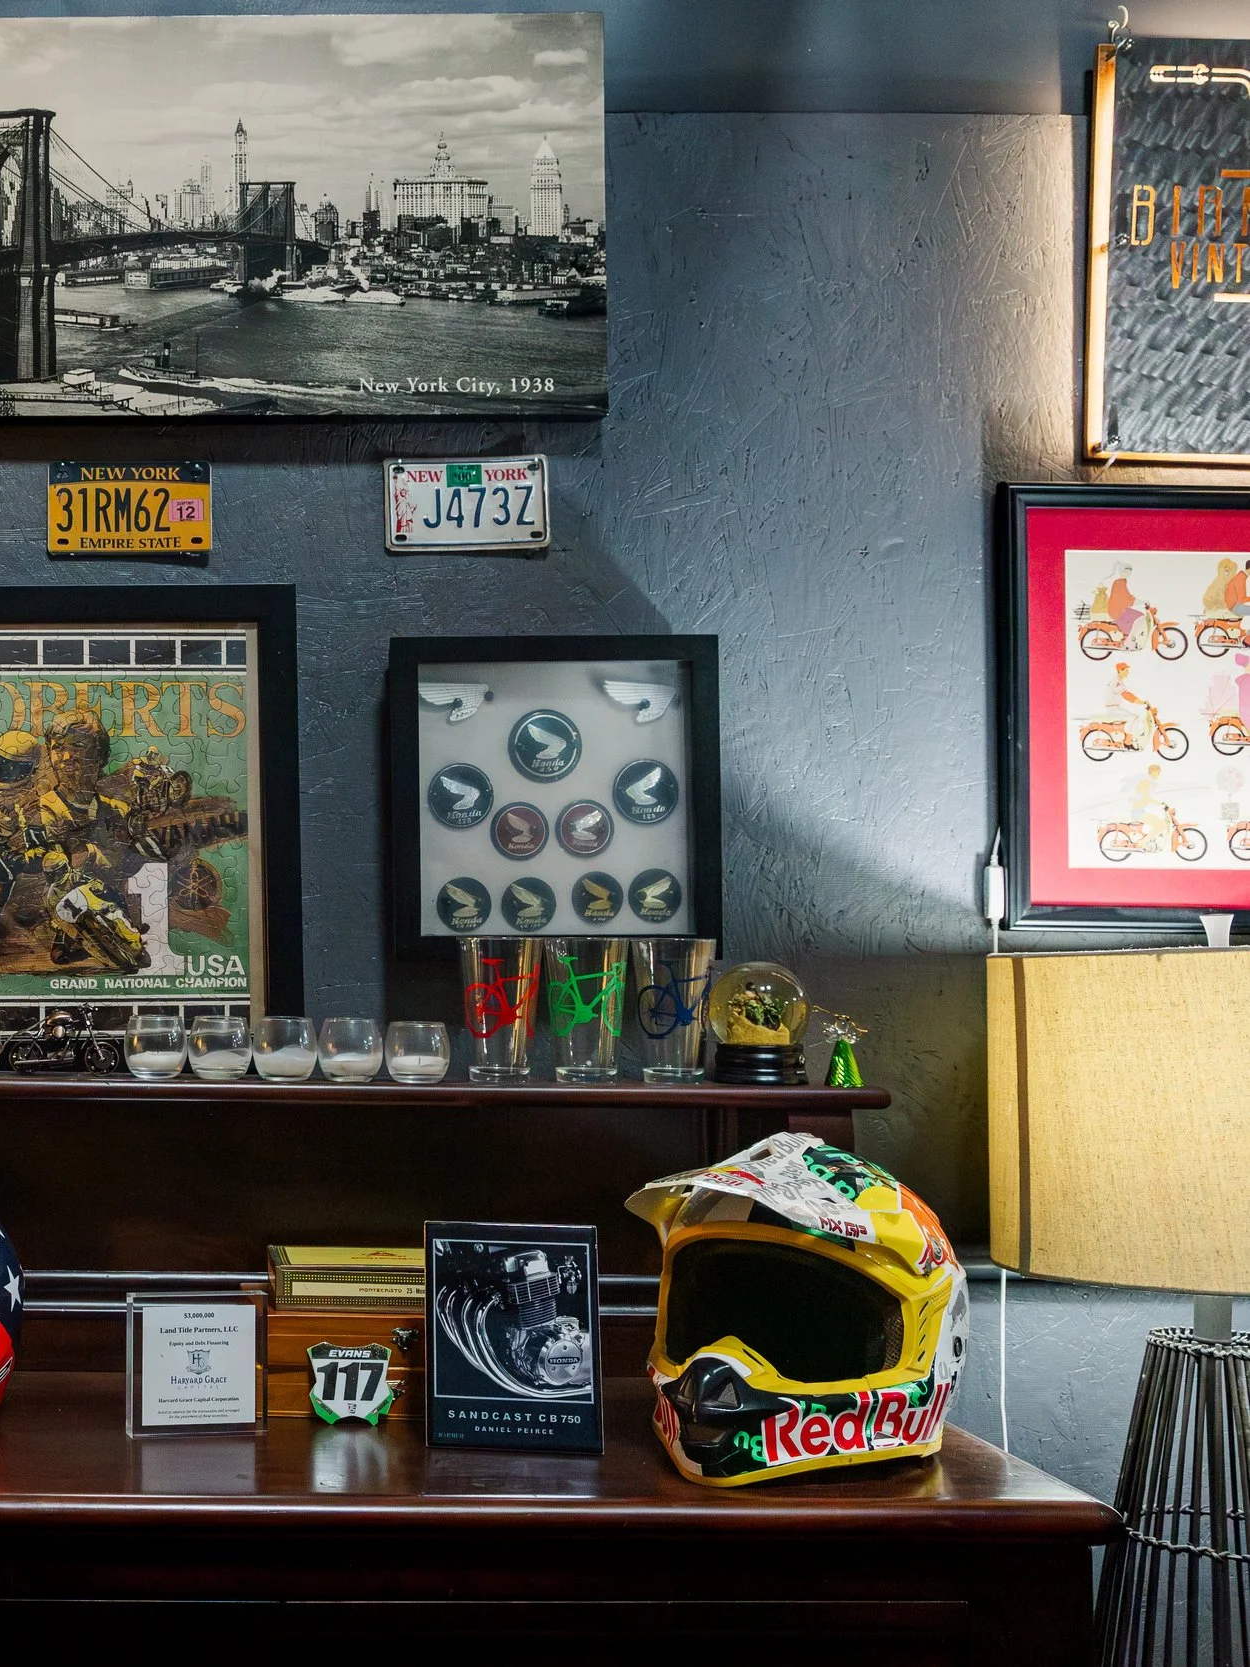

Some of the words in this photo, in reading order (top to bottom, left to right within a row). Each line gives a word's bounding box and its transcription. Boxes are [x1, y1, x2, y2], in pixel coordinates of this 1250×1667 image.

[359, 377, 400, 393] New
[405, 377, 449, 393] York
[456, 377, 501, 397] City,
[510, 377, 555, 393] 1938
[79, 467, 126, 481] NEW
[130, 467, 181, 481] YORK
[406, 470, 444, 483] NEW
[483, 468, 528, 482] YORK
[56, 487, 171, 533] 31RM62
[176, 505, 196, 519] 12
[422, 484, 536, 529] J473Z
[80, 537, 135, 549] EMPIRE
[138, 536, 182, 548] STATE
[187, 954, 246, 976] USA
[50, 978, 98, 990] GRAND
[104, 978, 170, 989] NATIONAL
[175, 977, 248, 989] CHAMPION
[178, 1326, 193, 1334] Title
[194, 1326, 223, 1334] Partners,
[224, 1325, 239, 1333] LLC
[329, 1349, 372, 1359] EVANS
[549, 1357, 579, 1365] HONDA
[316, 1361, 384, 1402] 117
[448, 1410, 532, 1422] SANDCAST
[538, 1414, 558, 1424] CB
[560, 1414, 582, 1425] 750
[763, 1391, 871, 1463] Red
[871, 1382, 951, 1446] Bull
[474, 1425, 512, 1434] DANIEL
[517, 1427, 555, 1436] PEIRCE
